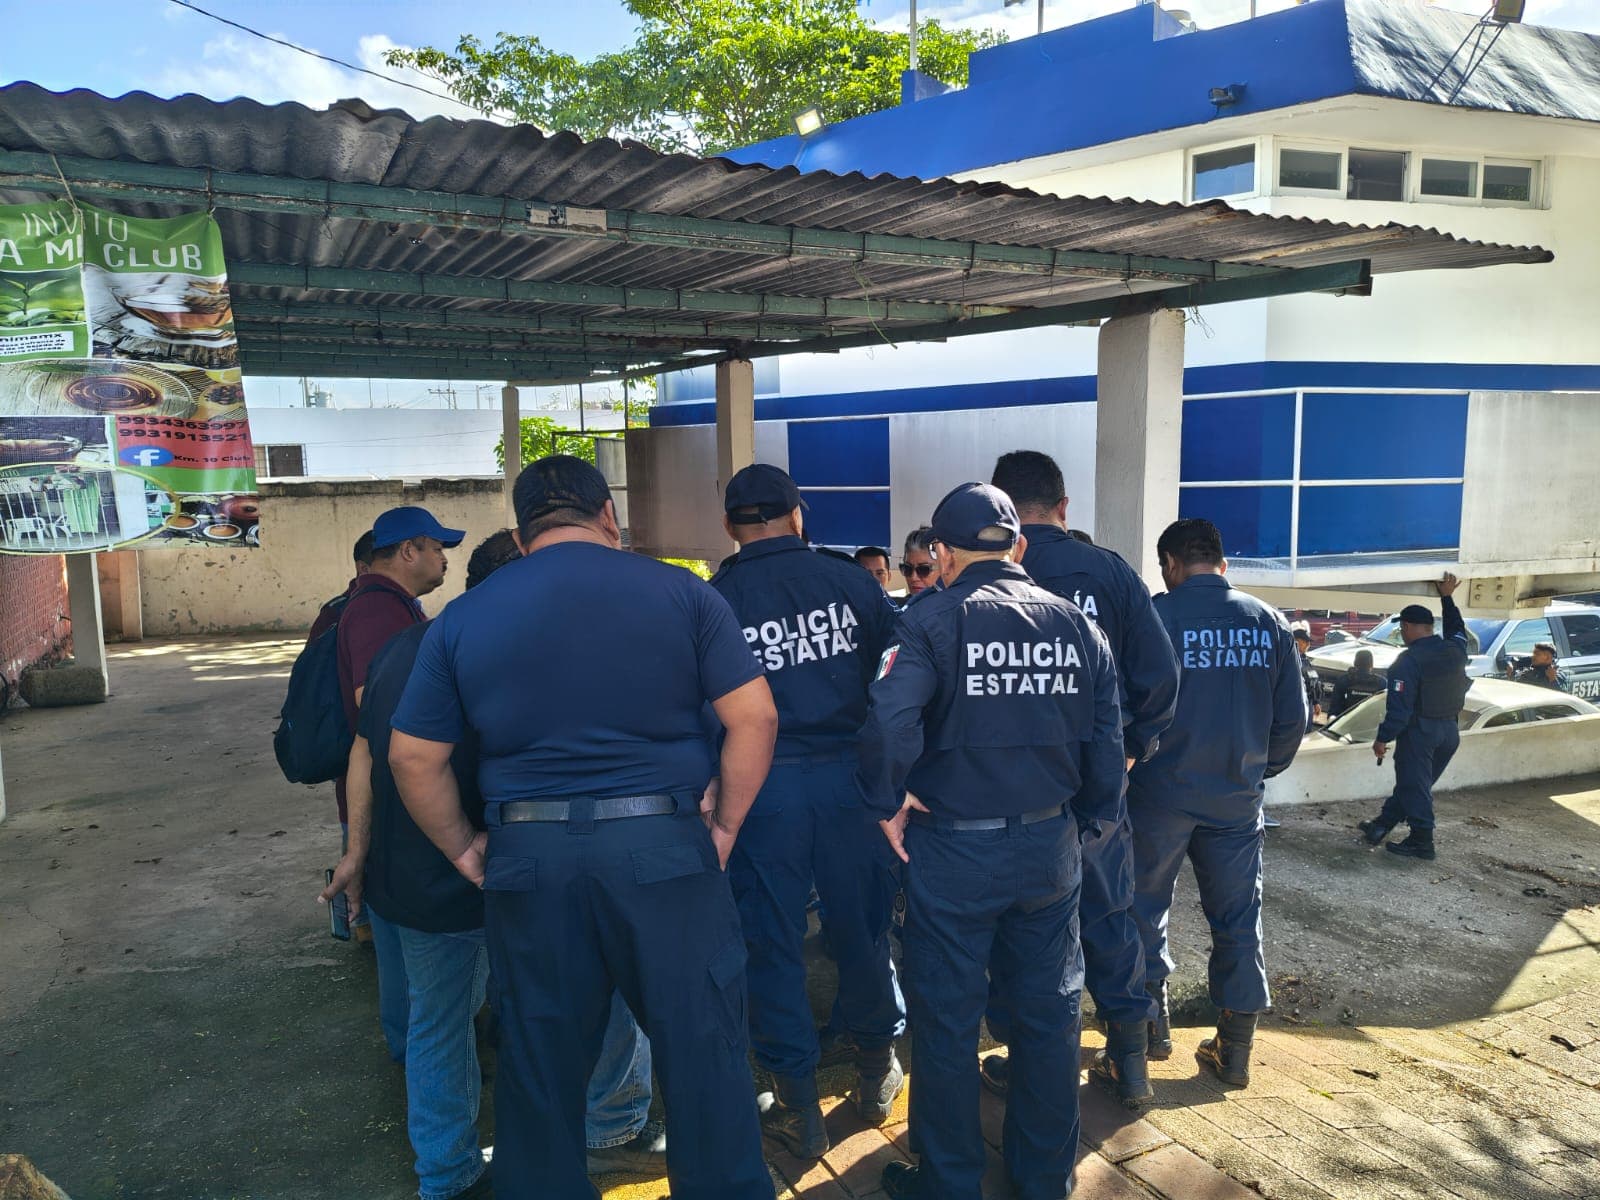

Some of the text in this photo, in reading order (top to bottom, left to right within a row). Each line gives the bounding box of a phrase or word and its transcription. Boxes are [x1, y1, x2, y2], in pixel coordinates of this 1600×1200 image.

[0, 234, 202, 270] A MI CLUB
[119, 428, 248, 442] 9931913521
[174, 455, 199, 463] Km.
[742, 602, 859, 646] POLICÍA
[1183, 626, 1273, 649] POLICÍA
[966, 637, 1082, 668] POLICÍA
[1183, 648, 1270, 669] ESTATAL
[966, 673, 1079, 696] ESTATAL
[1572, 680, 1600, 698] ESTA
